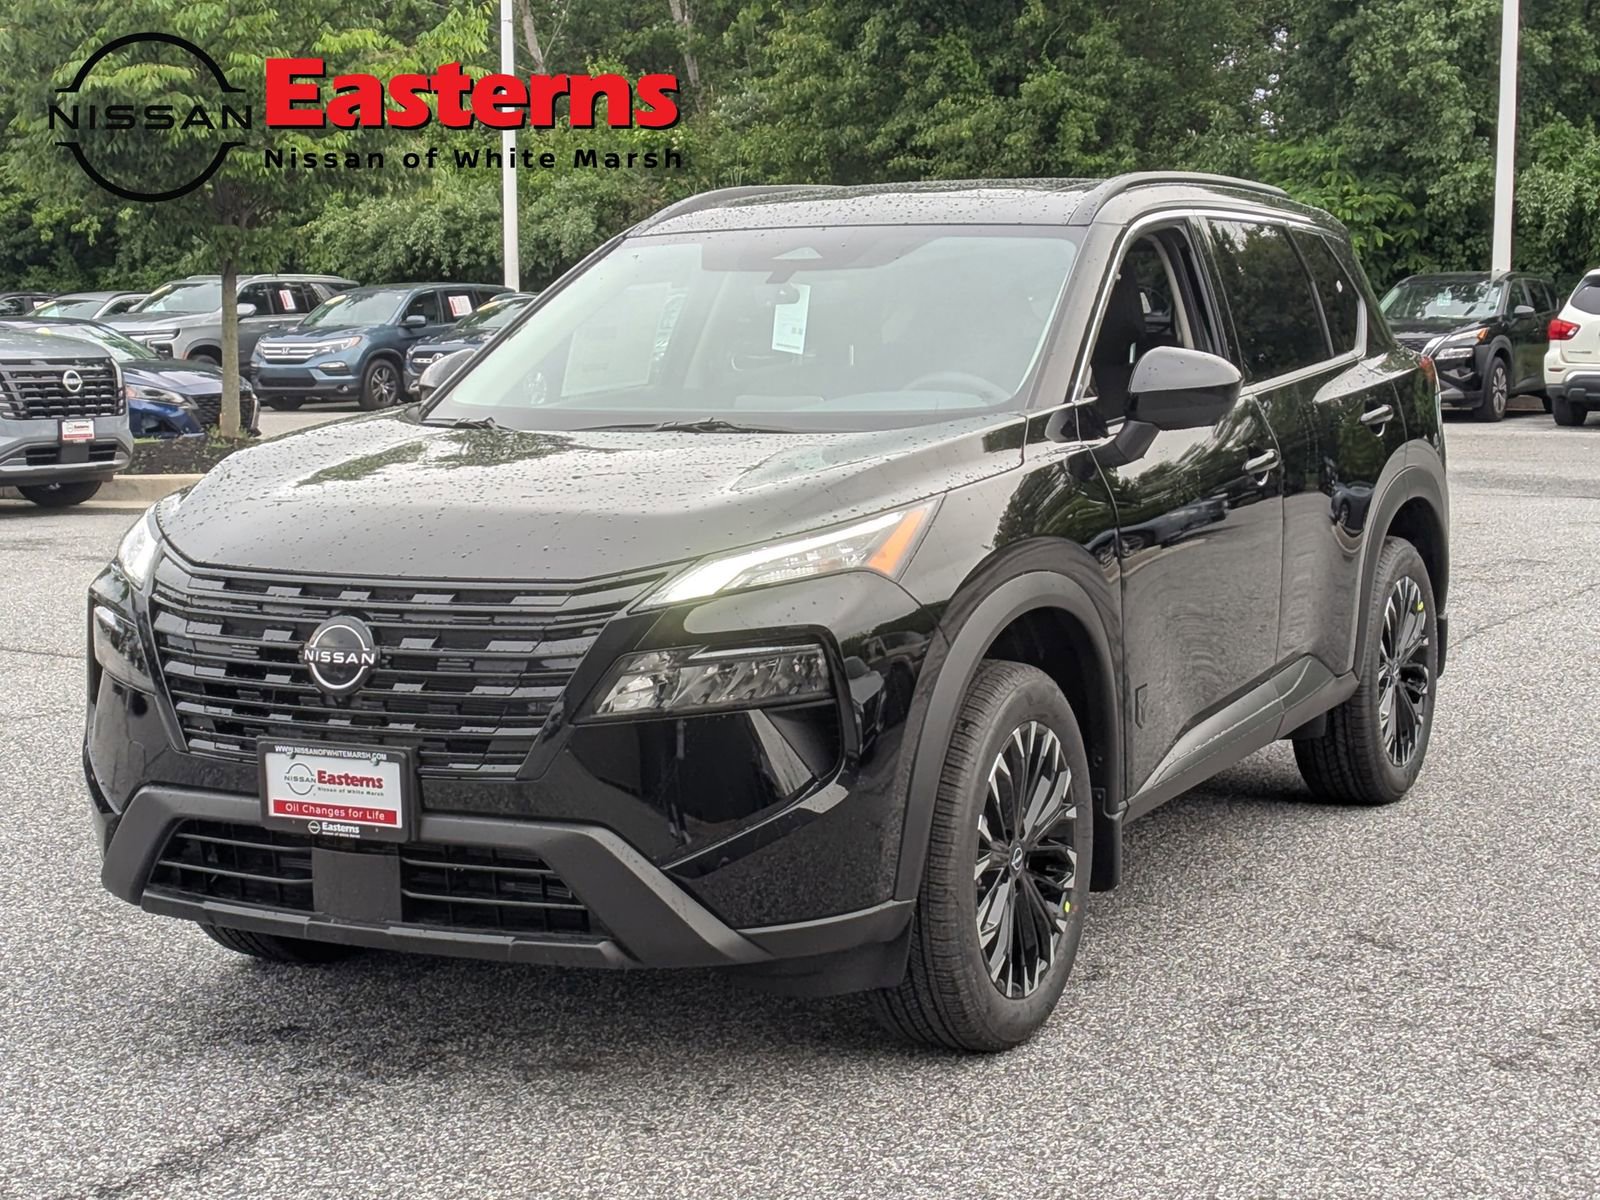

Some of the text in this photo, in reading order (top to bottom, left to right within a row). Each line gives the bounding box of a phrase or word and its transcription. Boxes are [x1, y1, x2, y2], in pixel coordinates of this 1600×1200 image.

[304, 649, 375, 665] NISSAN
[284, 775, 316, 783] NISSAN
[317, 770, 384, 789] Easterns
[285, 802, 385, 820] Oil Changes for Life
[322, 822, 360, 833] Easterns
